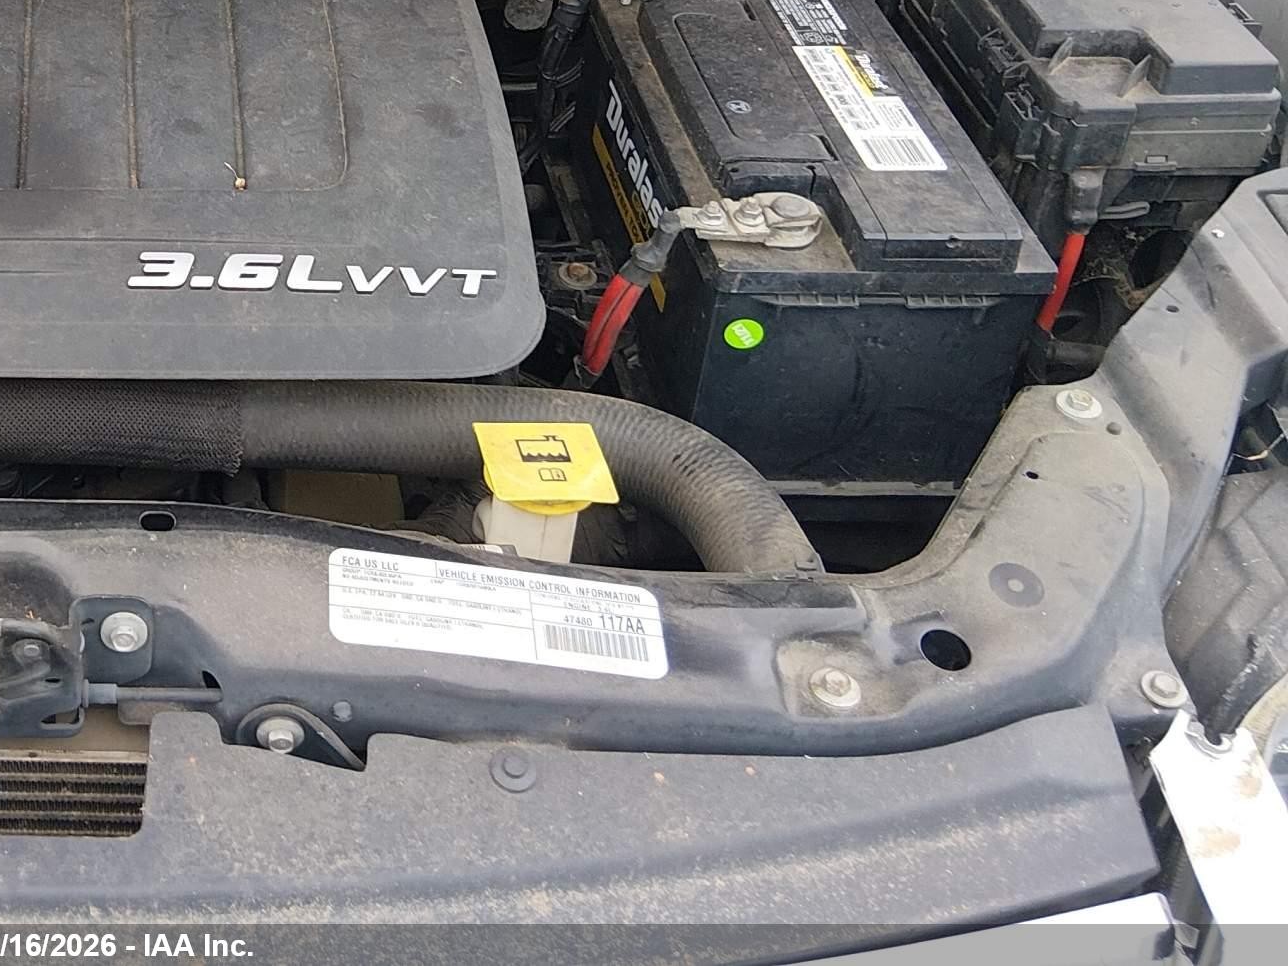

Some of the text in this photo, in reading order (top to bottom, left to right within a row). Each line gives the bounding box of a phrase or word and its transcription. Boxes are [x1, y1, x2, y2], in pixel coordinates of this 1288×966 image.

[606, 79, 663, 229] Duralas
[127, 251, 497, 297] 3.6L VVT
[341, 555, 400, 572] FCA US LLC
[438, 568, 477, 582] VEHICLE
[480, 574, 526, 588] EMISSION
[528, 579, 572, 595] CONTROL
[575, 586, 642, 604] INFORMATION
[599, 613, 646, 635] 117AA
